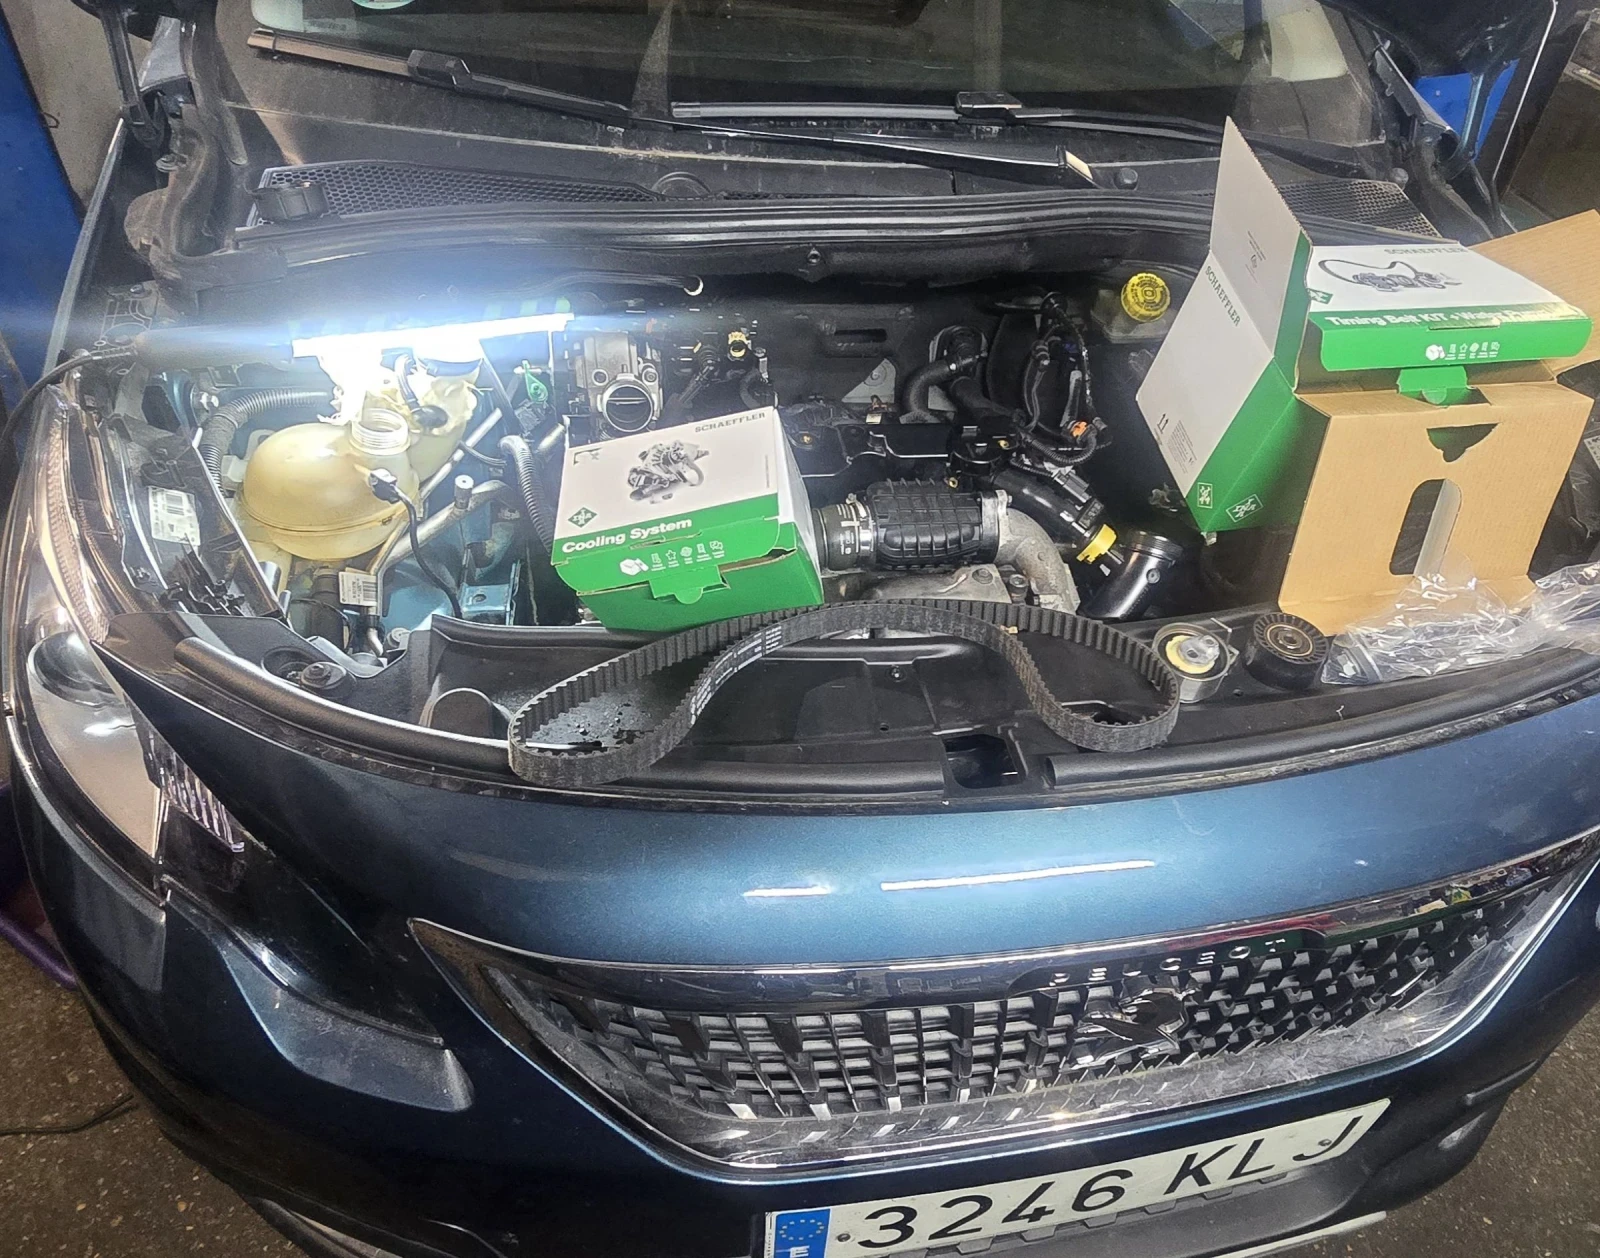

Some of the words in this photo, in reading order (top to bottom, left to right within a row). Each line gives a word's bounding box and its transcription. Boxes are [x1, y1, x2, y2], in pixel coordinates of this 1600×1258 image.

[1204, 265, 1241, 327] SCHAEFFLER
[1324, 315, 1386, 327] Timing
[1387, 314, 1420, 326] Belt
[1421, 312, 1449, 323] KIT
[694, 412, 766, 433] SCHAEFFLER
[561, 532, 626, 553] Cooling
[629, 518, 693, 540] System
[857, 1168, 1134, 1249] 3246
[1163, 1115, 1364, 1196] KLJ
